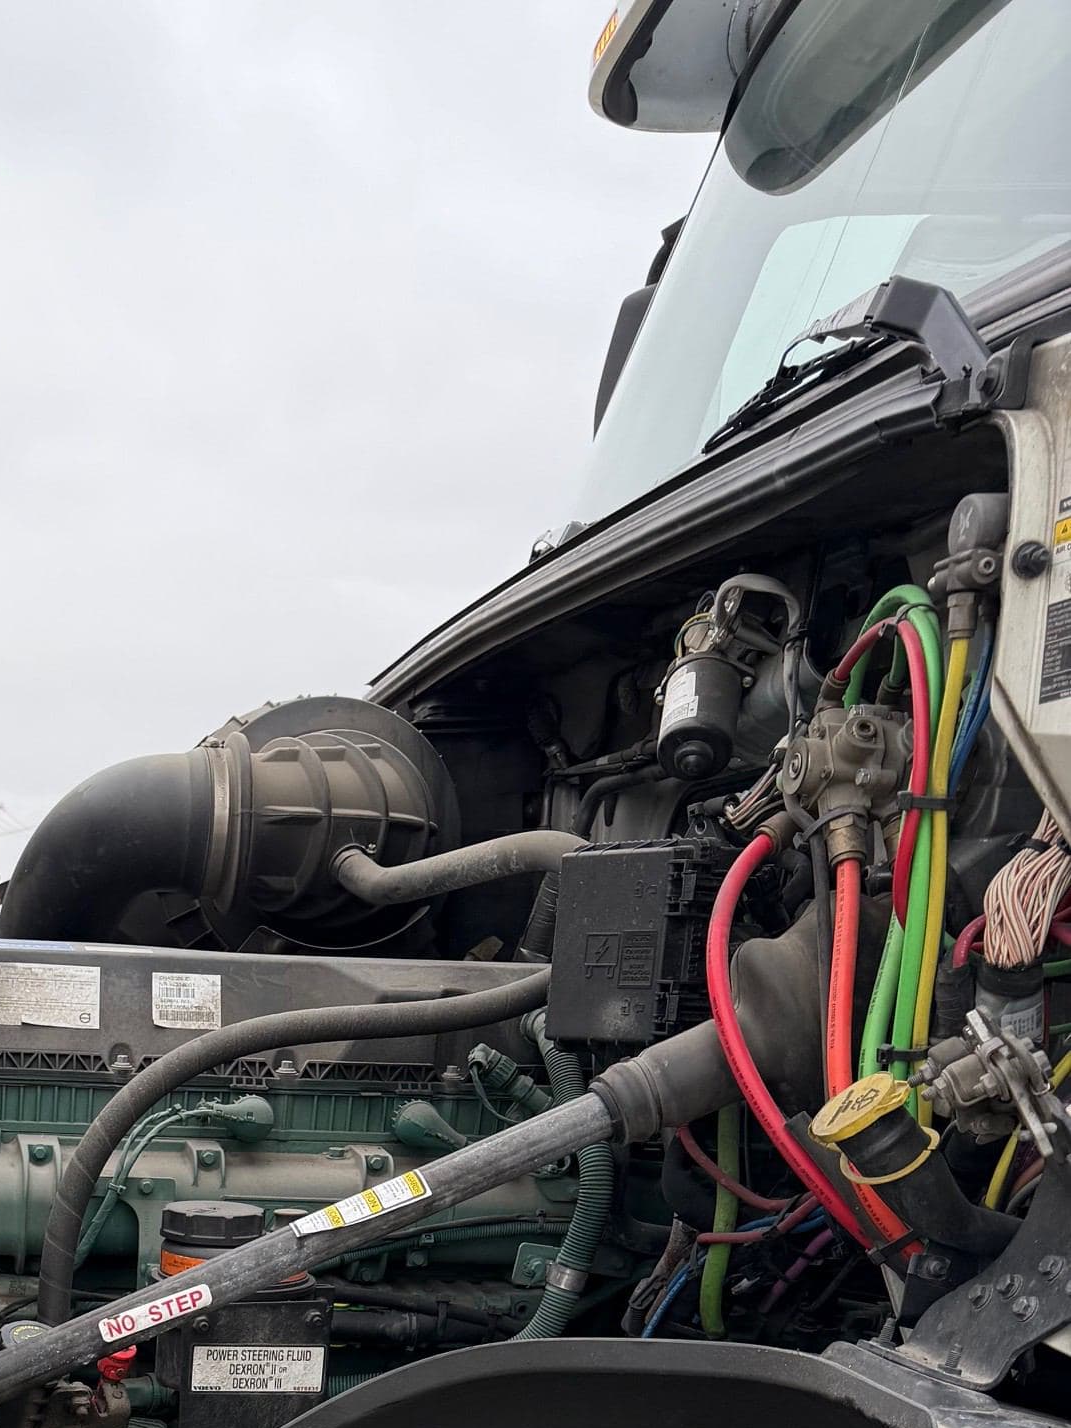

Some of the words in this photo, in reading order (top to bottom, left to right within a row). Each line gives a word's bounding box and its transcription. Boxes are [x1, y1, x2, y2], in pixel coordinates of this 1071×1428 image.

[104, 1314, 136, 1338] NO
[148, 1290, 203, 1322] STEP
[206, 1349, 238, 1361] POWER
[241, 1349, 284, 1361] STEERING
[287, 1350, 312, 1361] FLUID
[274, 1377, 282, 1389] III
